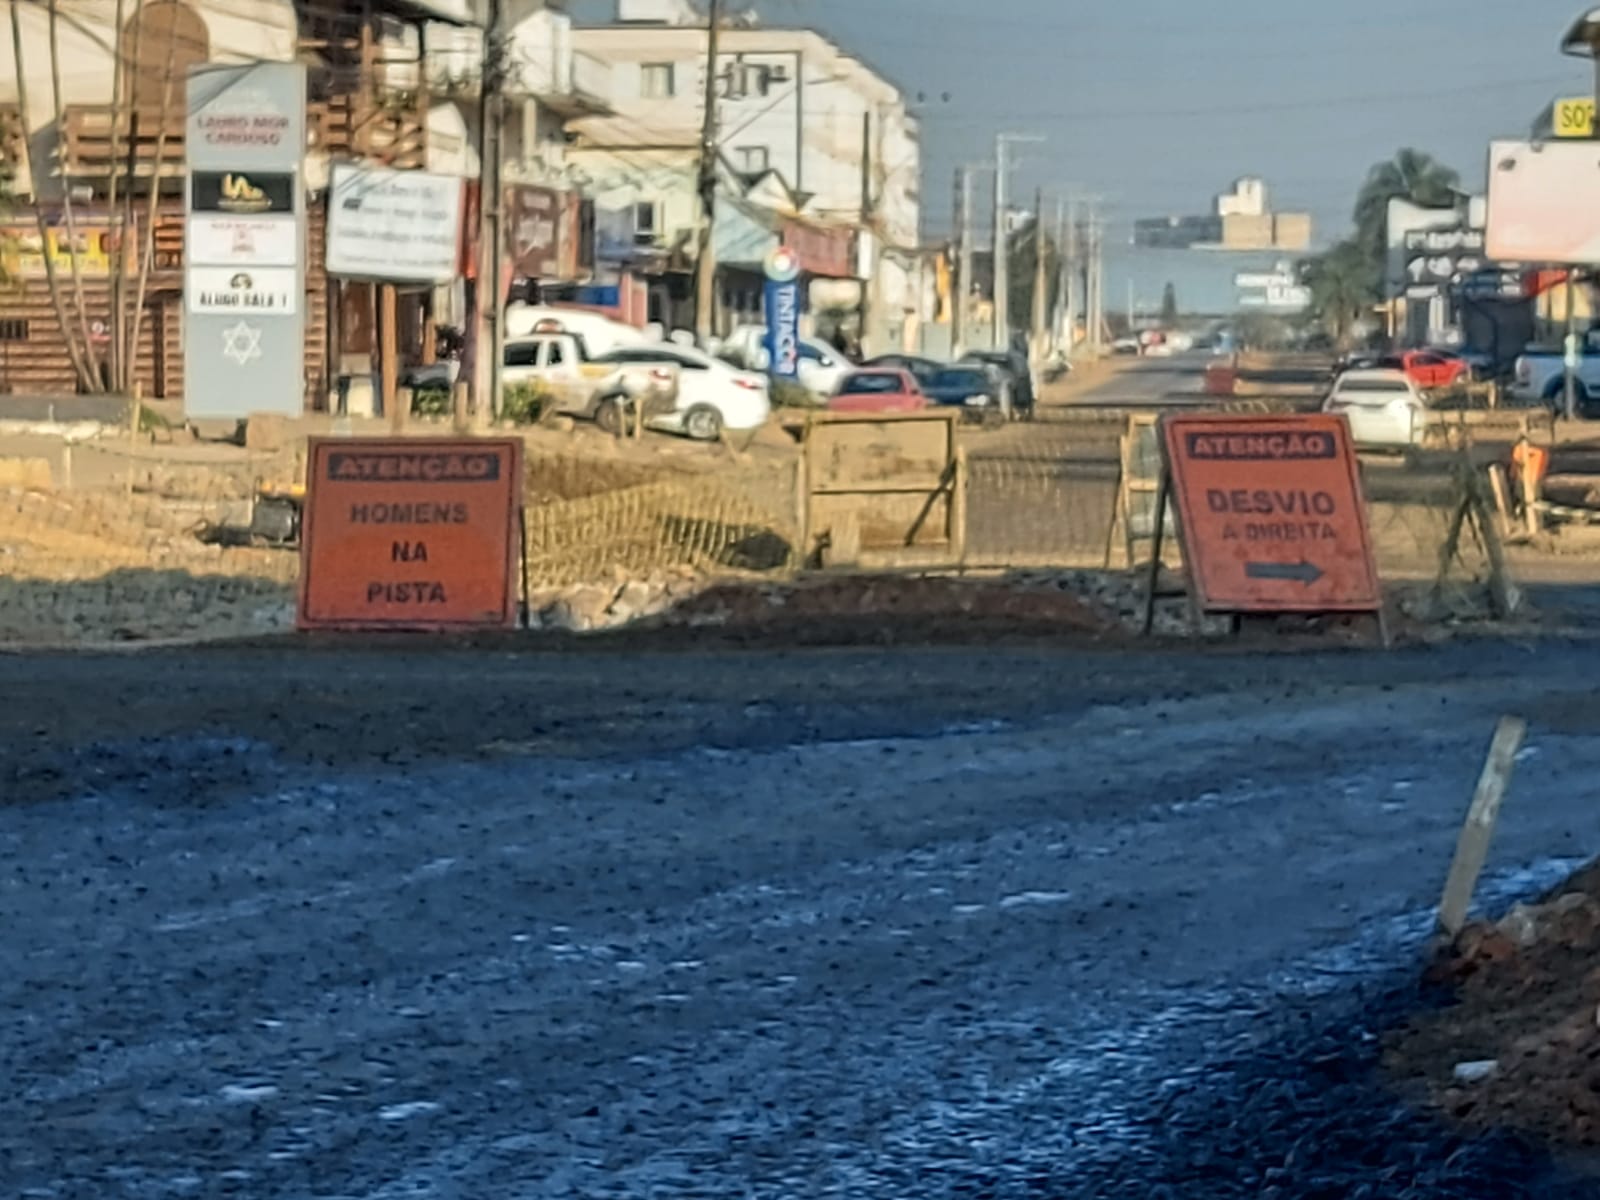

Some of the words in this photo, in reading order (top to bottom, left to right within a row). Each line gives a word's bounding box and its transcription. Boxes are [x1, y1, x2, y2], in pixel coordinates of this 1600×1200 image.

[200, 291, 239, 306] ALUGO
[244, 292, 274, 307] SALA
[351, 502, 468, 524] HOMENS
[1206, 489, 1335, 516] DESVIO
[1245, 522, 1337, 542] DIREITA
[392, 541, 427, 562] NA
[367, 581, 446, 604] PISTA
